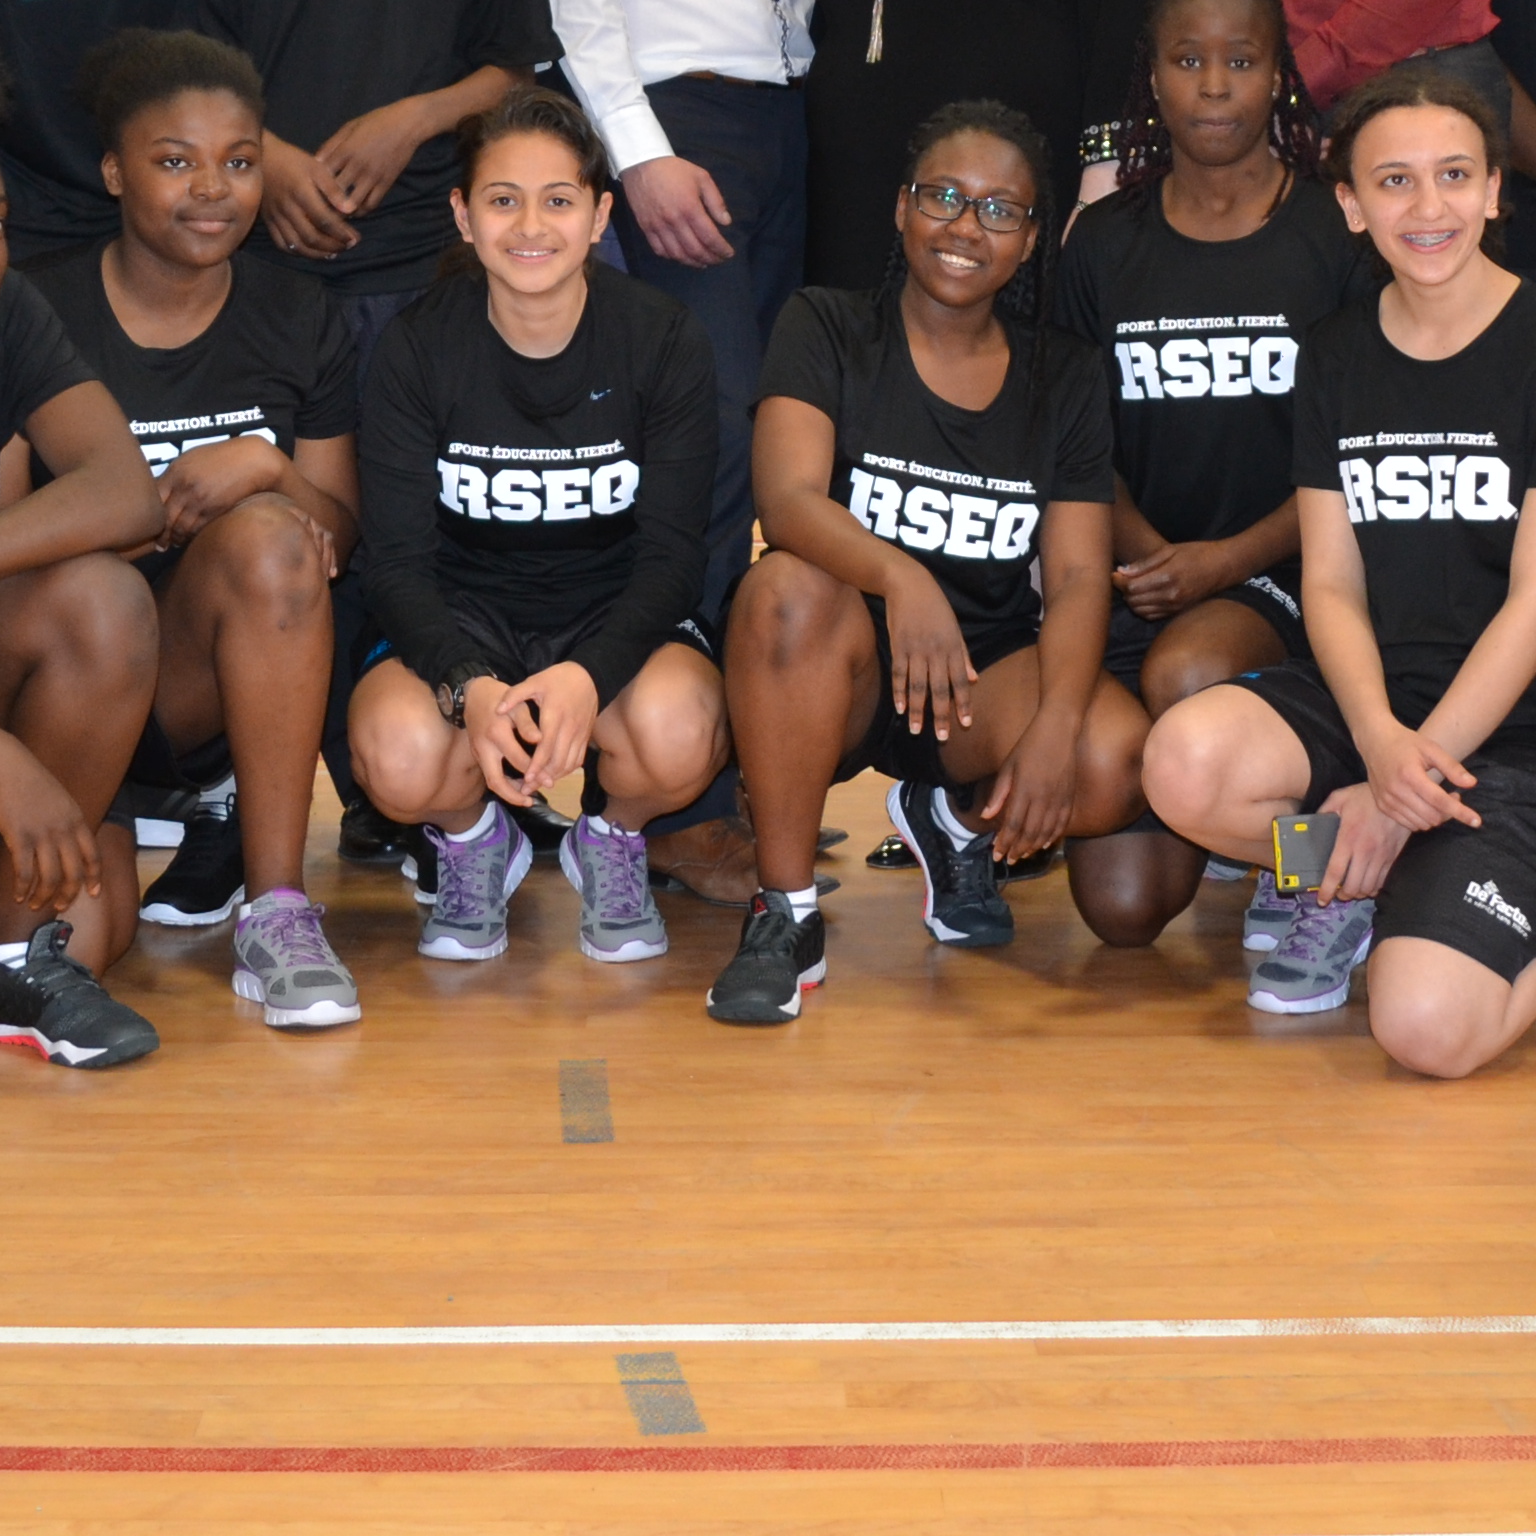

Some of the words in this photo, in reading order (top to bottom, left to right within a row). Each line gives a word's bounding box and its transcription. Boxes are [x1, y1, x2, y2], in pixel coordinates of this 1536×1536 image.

[1116, 319, 1157, 334] SPORT.
[1158, 317, 1236, 330] ÉDUCATION.
[1238, 313, 1289, 327] FIERTÉ.
[1114, 336, 1299, 400] RSEQ
[129, 415, 214, 434] ÉDUCATION.
[214, 406, 265, 426] FIERTÉ.
[1447, 431, 1498, 446] FIERTÉ.
[448, 442, 490, 458] SPORT.
[492, 445, 575, 460] ÉDUCATION.
[576, 438, 625, 459] FIERTÉ.
[437, 457, 640, 522] RSEQ
[864, 452, 907, 472] SPORT.
[909, 460, 985, 488] ÉDUCATION.
[986, 478, 1036, 494] FIERTÉ.
[1338, 455, 1518, 523] RSEQ
[849, 467, 1040, 559] RSEQ
[1466, 881, 1488, 902] De
[1489, 893, 1527, 925] Facto
